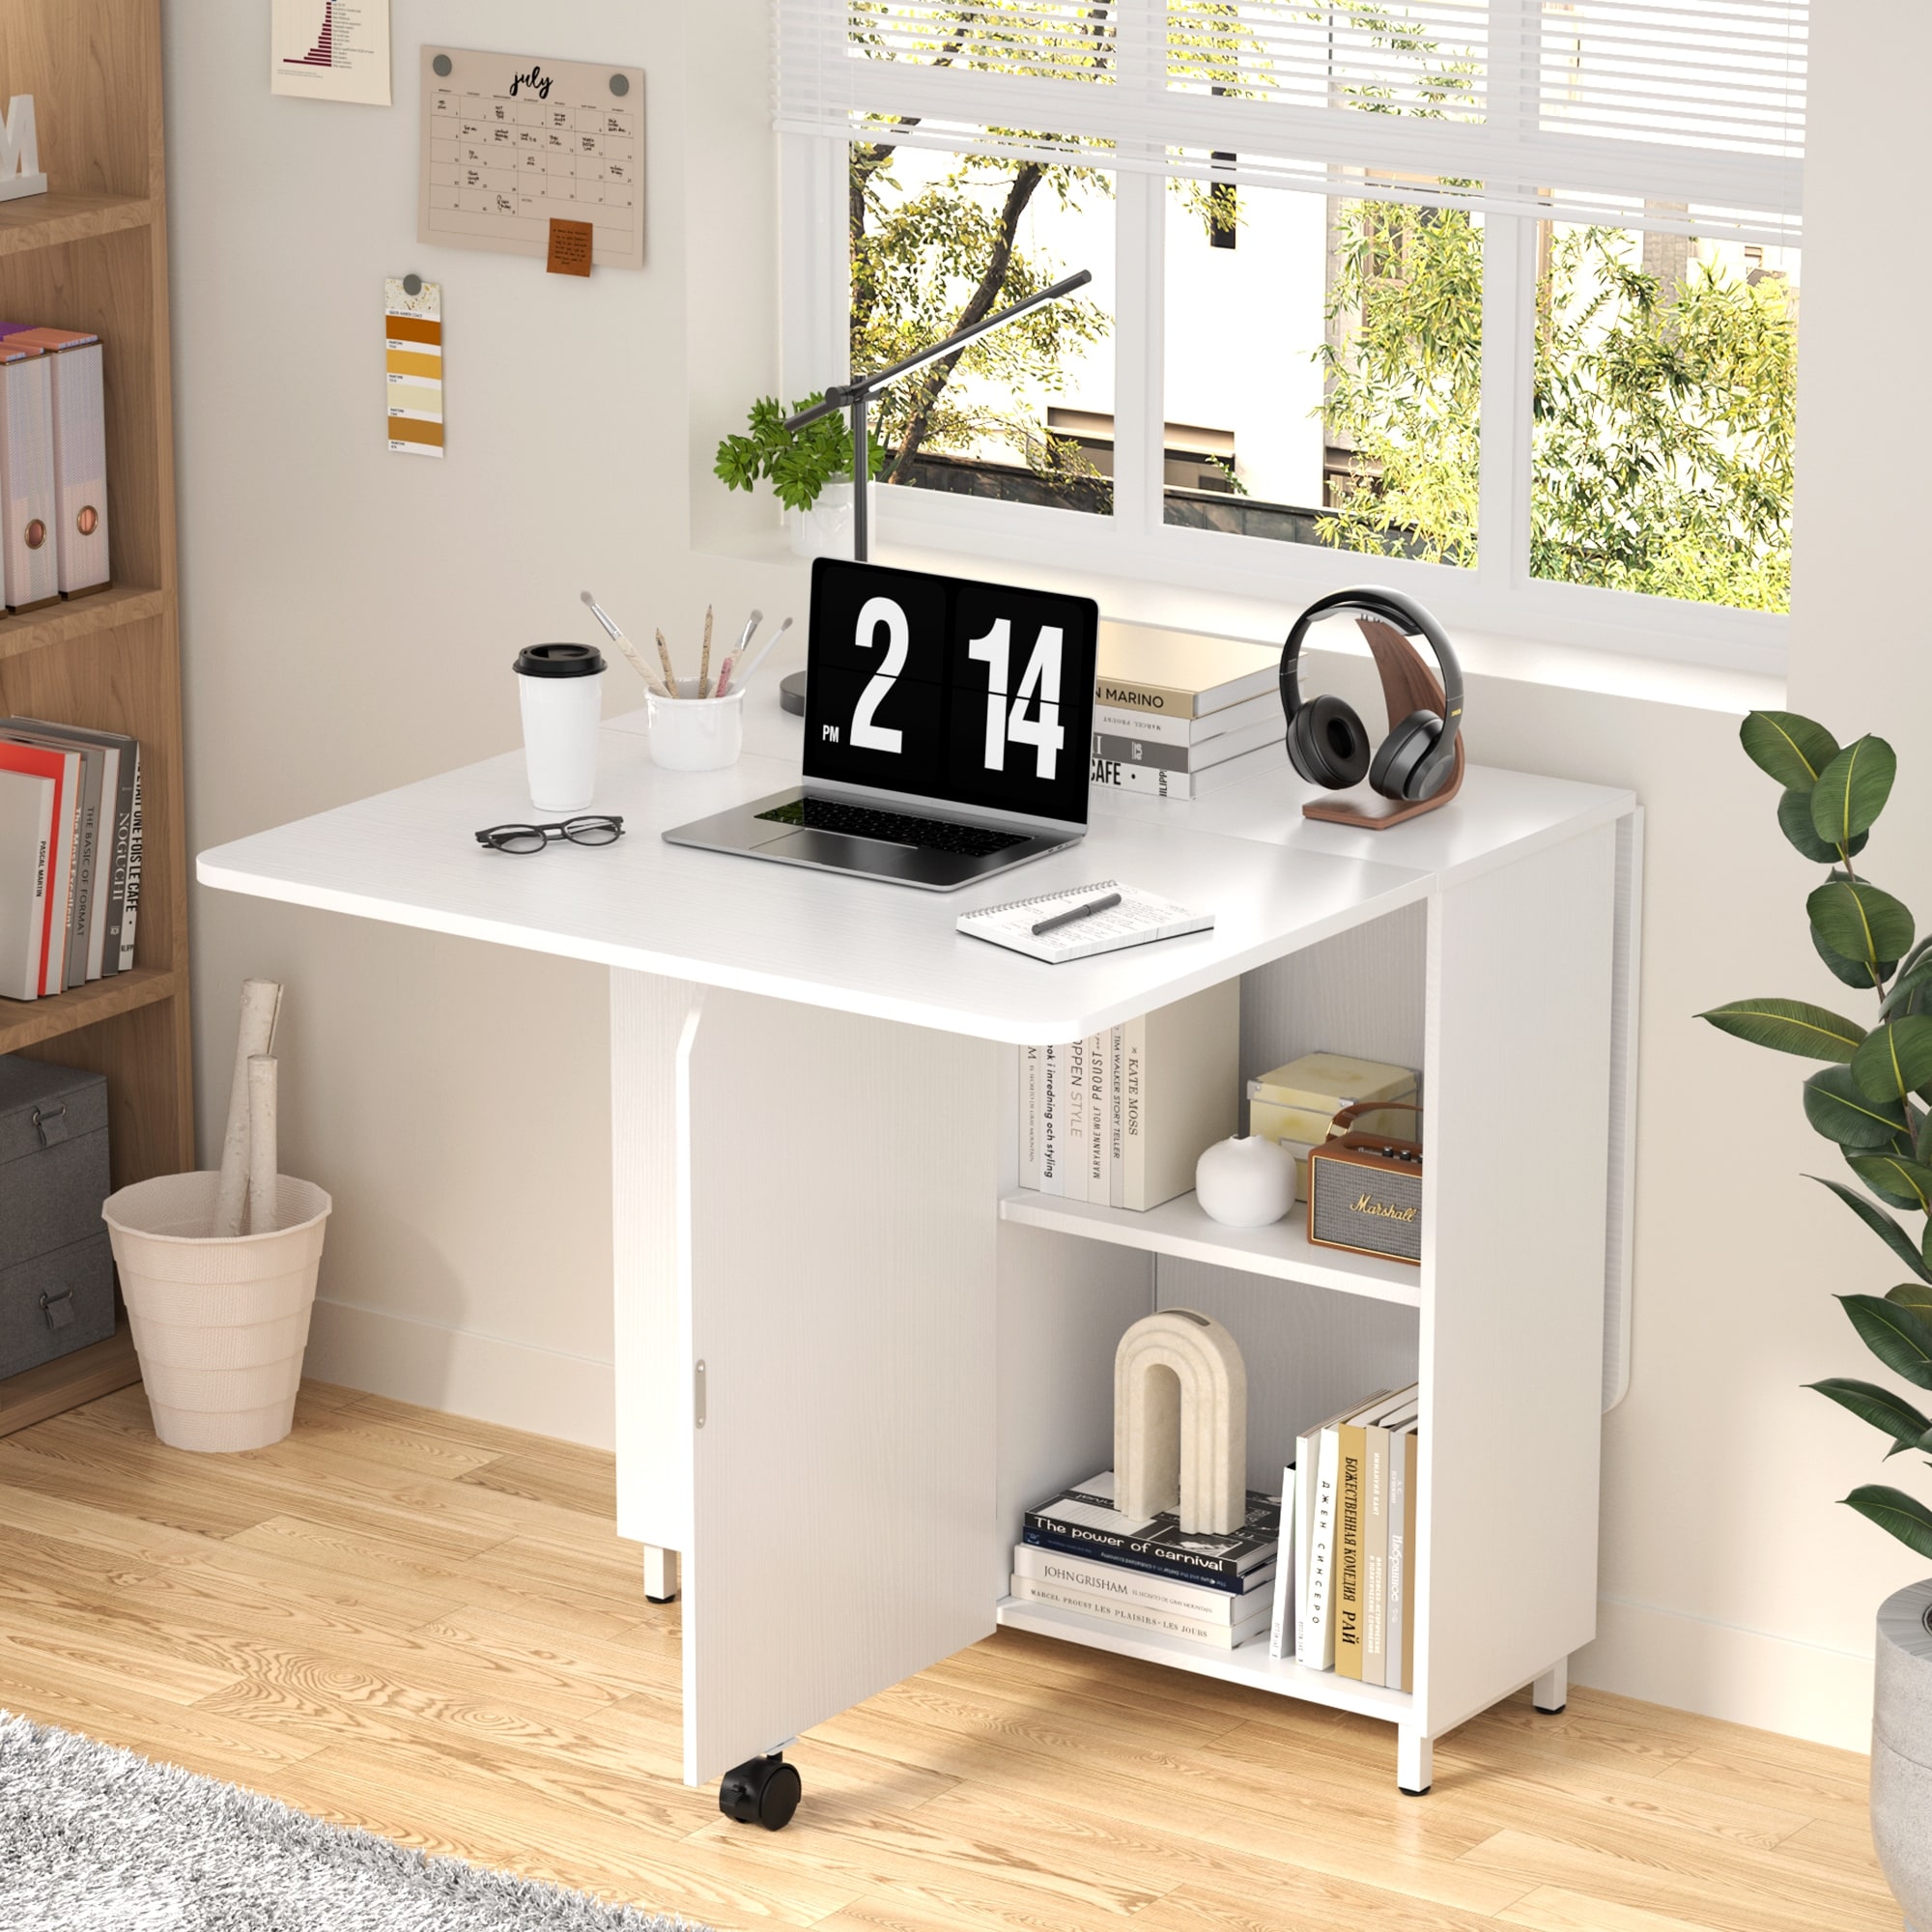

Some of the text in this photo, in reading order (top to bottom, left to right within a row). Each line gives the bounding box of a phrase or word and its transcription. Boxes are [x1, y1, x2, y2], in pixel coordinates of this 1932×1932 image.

[509, 66, 554, 99] july
[850, 596, 1065, 781] 2 14
[1106, 689, 1164, 708] MARINO
[822, 724, 839, 744] PM
[36, 840, 46, 897] PASCAL MARTIN
[77, 807, 95, 936] THE BASIC OF FORMAT
[113, 812, 130, 900] NOGUCHI
[128, 866, 142, 880] LE
[130, 837, 143, 863] FOIS
[126, 882, 140, 913] CAFE
[1044, 1069, 1056, 1120] inredning
[1092, 1051, 1103, 1100] PROUST
[1128, 1057, 1139, 1136] KATE MOSS
[1046, 1122, 1055, 1141] och
[1070, 1091, 1082, 1139] STYLE
[1093, 1106, 1101, 1130] WOLF
[1044, 1144, 1055, 1179] styling
[1093, 1131, 1101, 1179] MARYANNE
[1350, 1194, 1417, 1223] Marshall
[1035, 1517, 1066, 1534] The
[1071, 1528, 1124, 1547] power
[1130, 1543, 1151, 1553] of
[1154, 1548, 1223, 1572] carnival
[1312, 1481, 1330, 1624] ДЖЕН СИНСЕРО
[1342, 1457, 1359, 1645] БОЖЕСТВЕННАЯ КОМЕДИЯ РАЙ
[1389, 1534, 1404, 1603] Избранное
[1031, 1589, 1061, 1602] MARCEL
[1063, 1597, 1093, 1609] PROUST
[1094, 1605, 1111, 1614] LES
[1163, 1621, 1179, 1631] LES
[1181, 1625, 1208, 1637] JOURS
